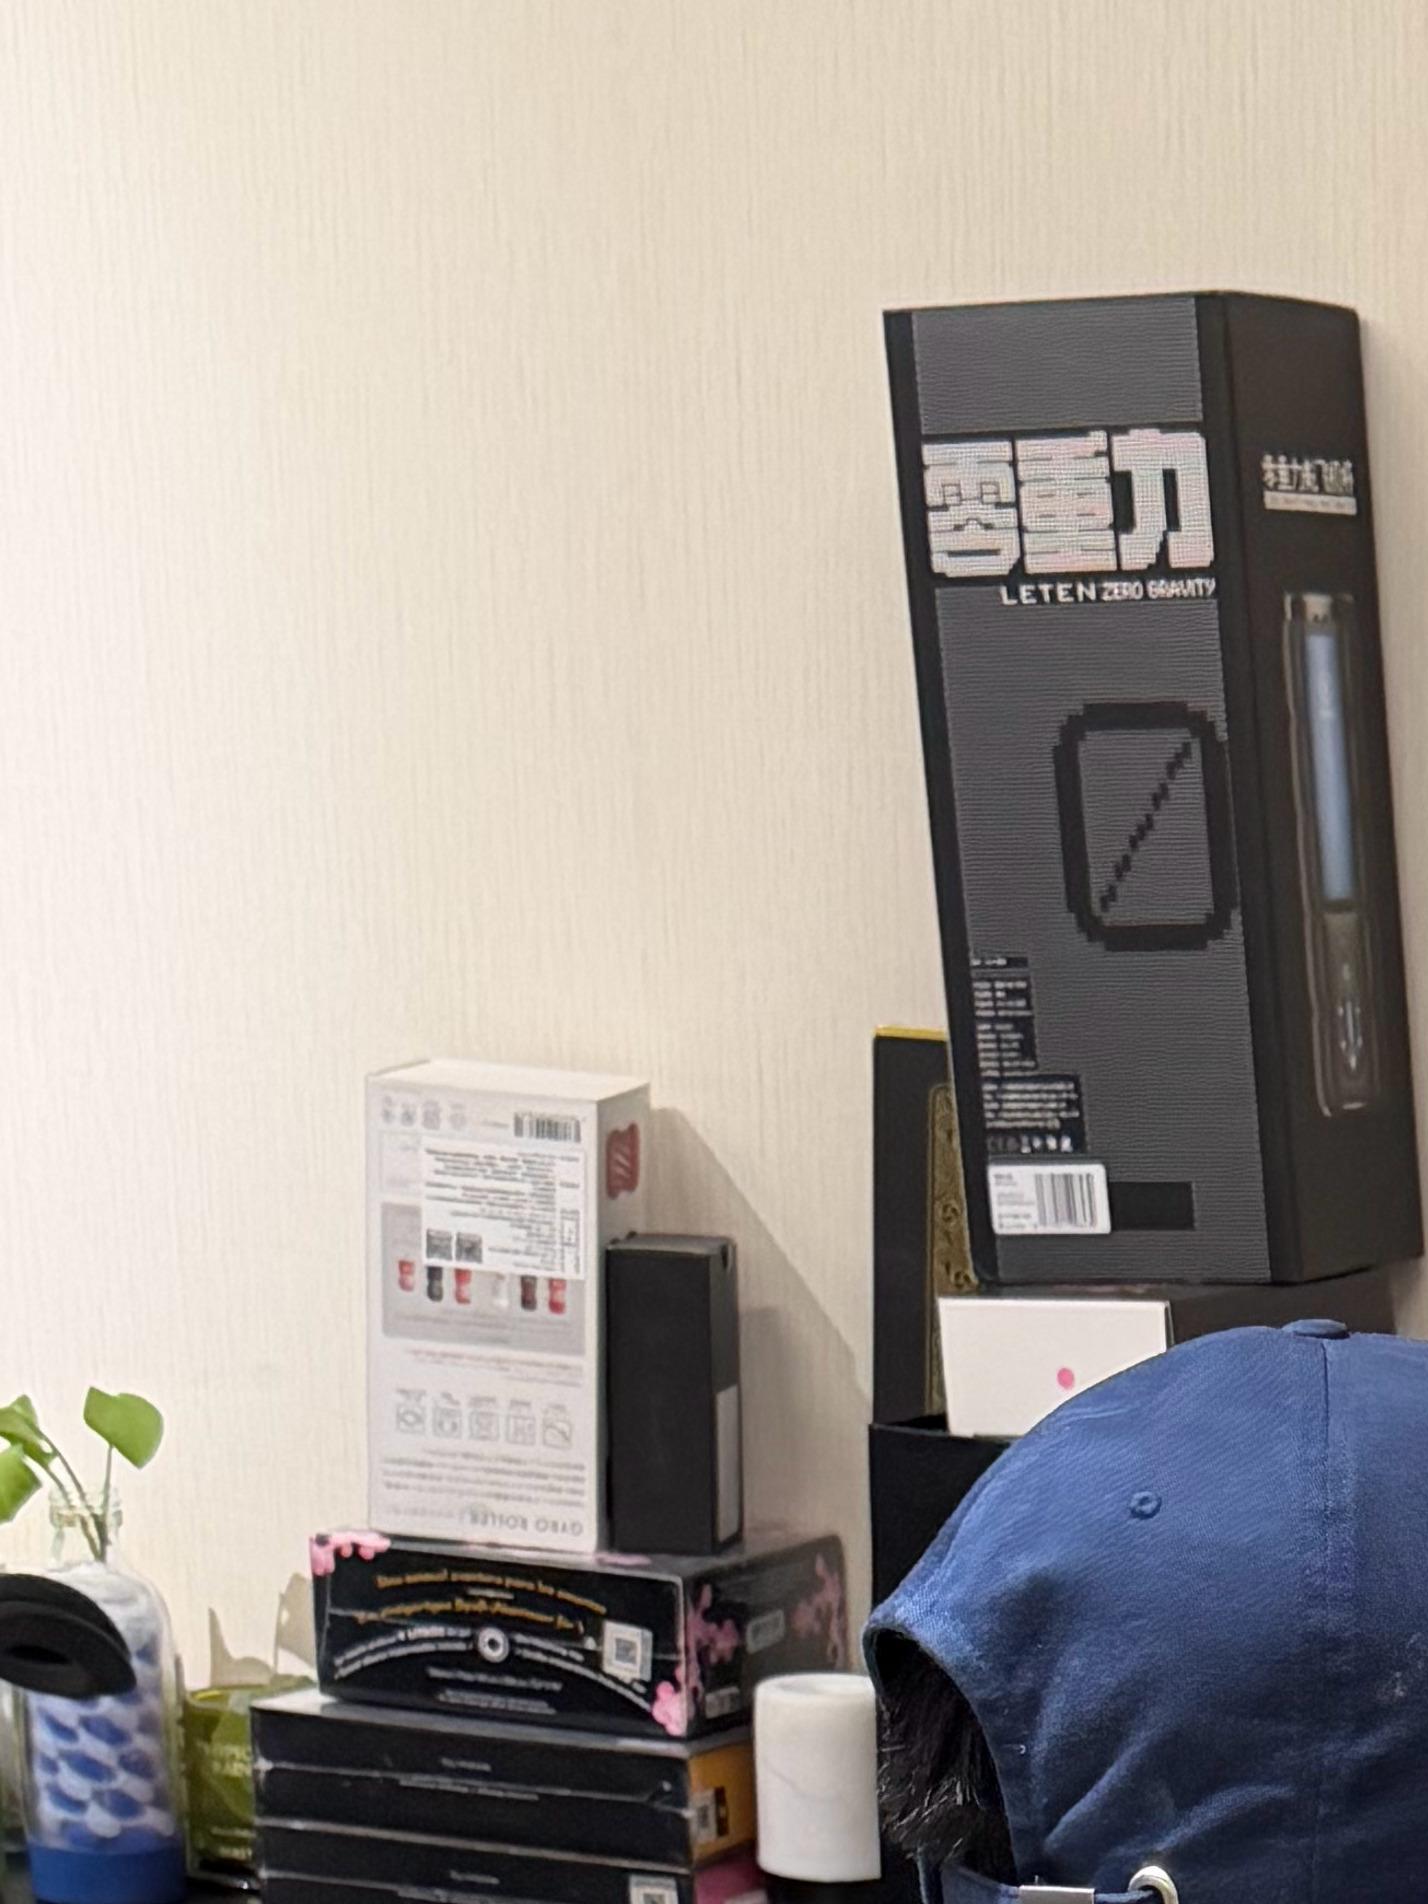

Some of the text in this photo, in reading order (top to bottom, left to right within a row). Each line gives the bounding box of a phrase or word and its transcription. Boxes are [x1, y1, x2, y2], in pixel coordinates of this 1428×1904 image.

[922, 428, 1214, 577] 零重力
[1000, 576, 1217, 605] LETEN ZERO GRAVITY
